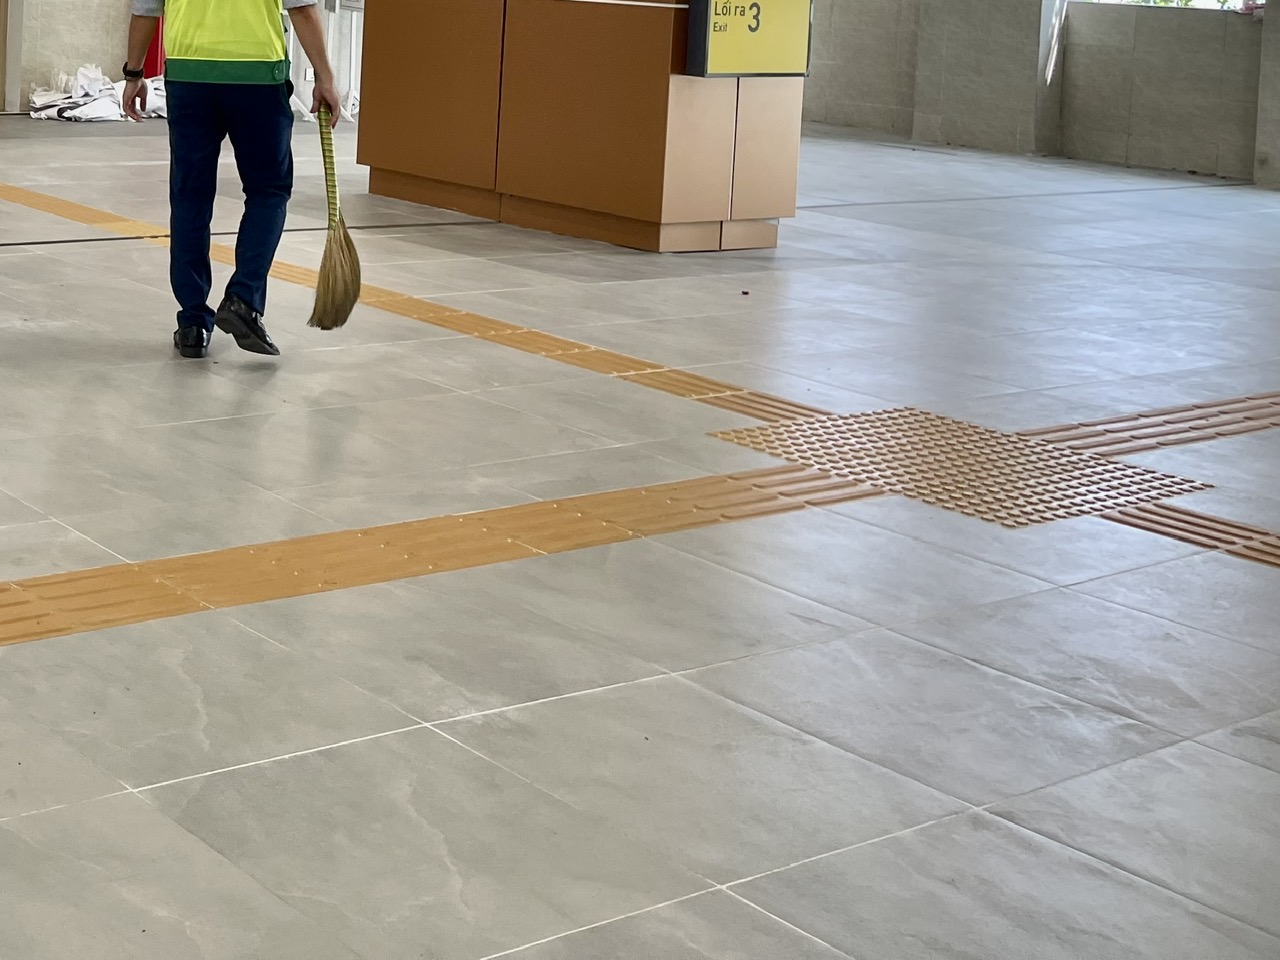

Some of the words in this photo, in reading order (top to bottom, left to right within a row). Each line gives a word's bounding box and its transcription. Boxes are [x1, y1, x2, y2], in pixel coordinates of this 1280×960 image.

[714, 0, 732, 16] Lối
[734, 6, 746, 16] ra
[748, 2, 761, 32] 3
[713, 22, 727, 32] Exit
